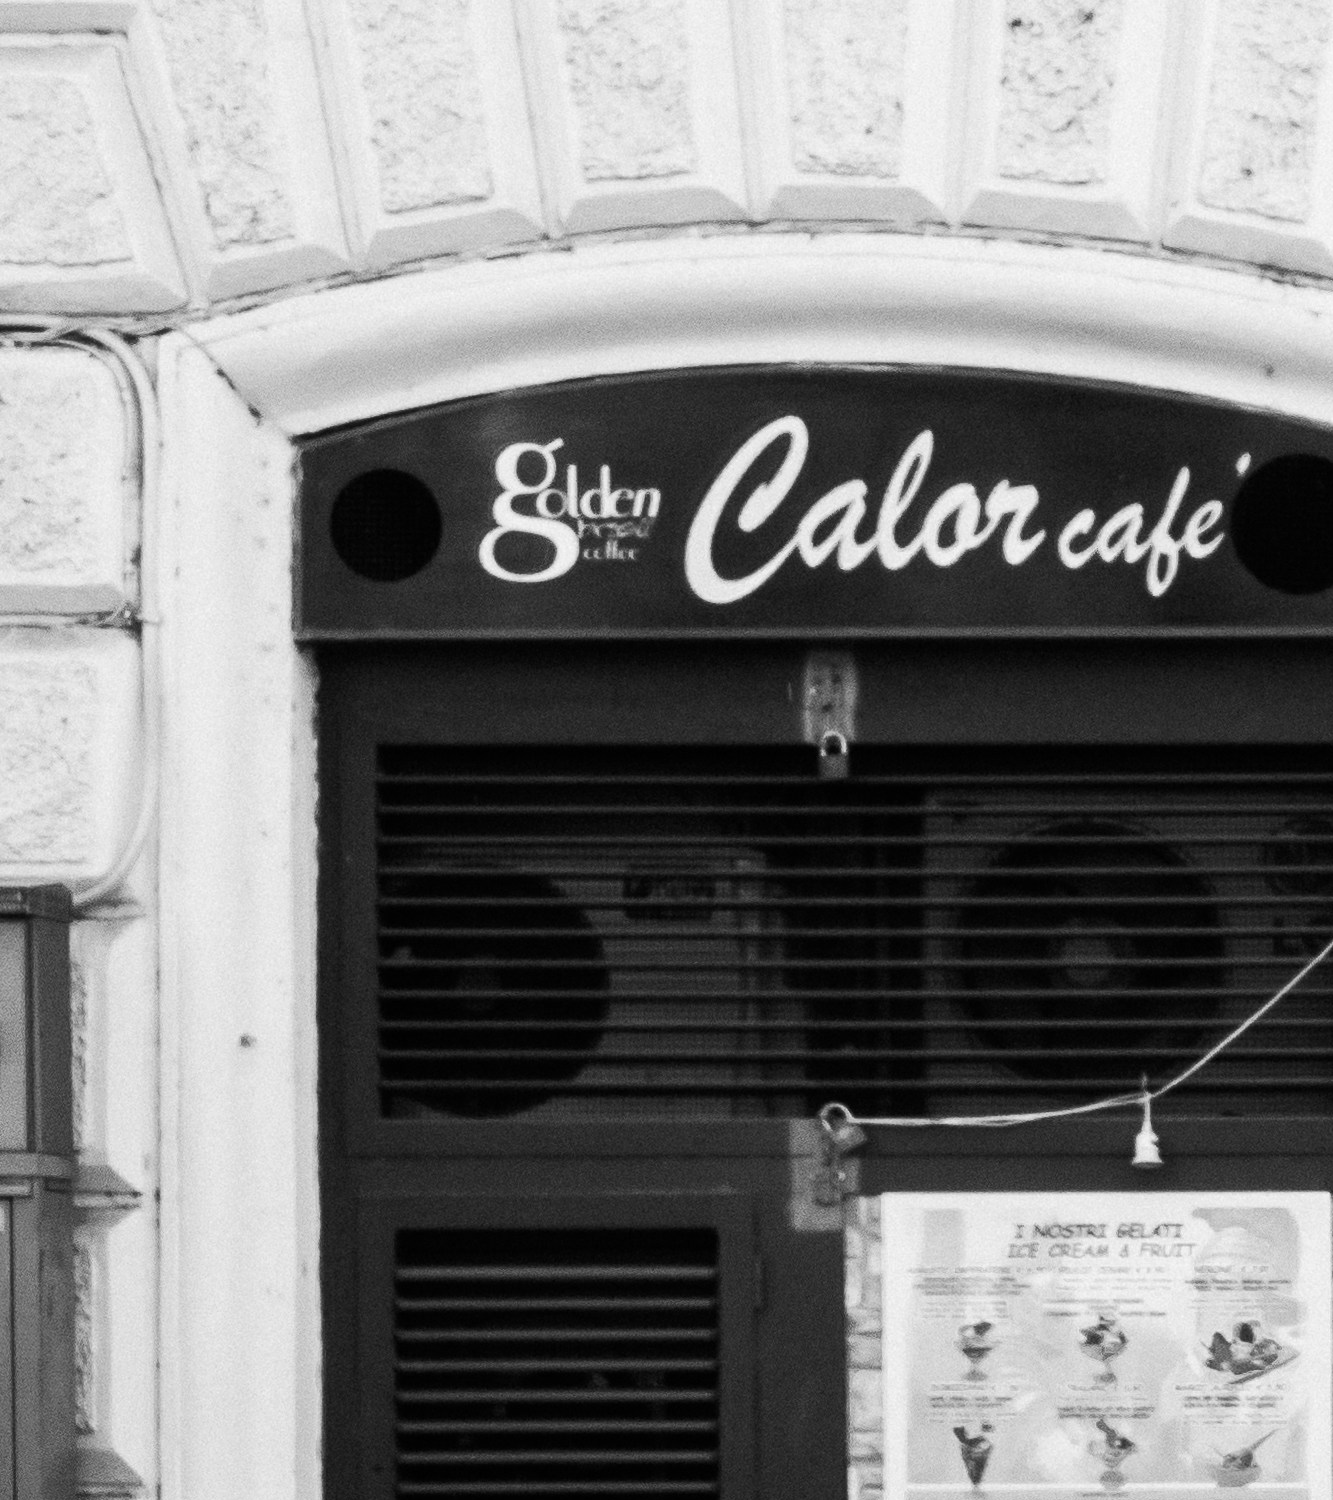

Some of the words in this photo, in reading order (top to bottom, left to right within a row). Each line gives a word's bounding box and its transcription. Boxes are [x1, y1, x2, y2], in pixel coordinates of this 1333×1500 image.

[478, 437, 661, 583] golden
[684, 416, 1042, 603] Calor
[1008, 1242, 1038, 1258] ICE
[1048, 1242, 1109, 1257] CREAM
[1139, 1241, 1197, 1257] FRUIT
[1033, 1223, 1107, 1238] NOSTRI
[1116, 1223, 1183, 1238] GELATI
